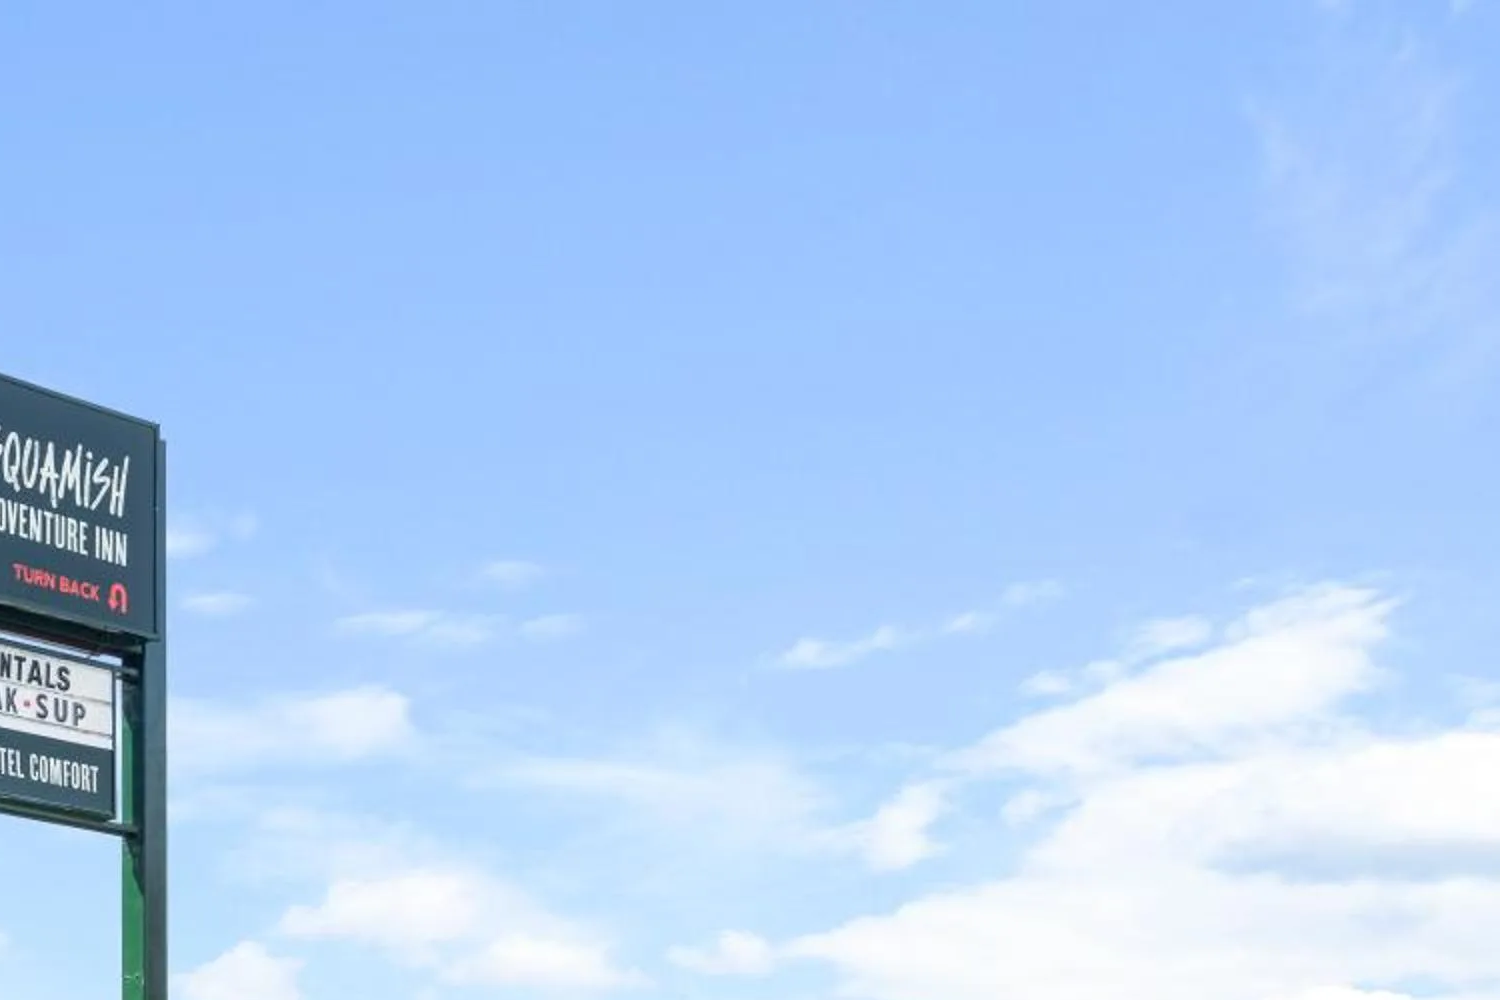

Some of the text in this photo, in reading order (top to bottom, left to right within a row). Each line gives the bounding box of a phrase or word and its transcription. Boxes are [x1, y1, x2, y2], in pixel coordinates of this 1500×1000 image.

[95, 527, 128, 567] INN
[12, 563, 100, 601] TURN BACK
[35, 693, 87, 727] SUP
[29, 753, 99, 793] COMFORT
